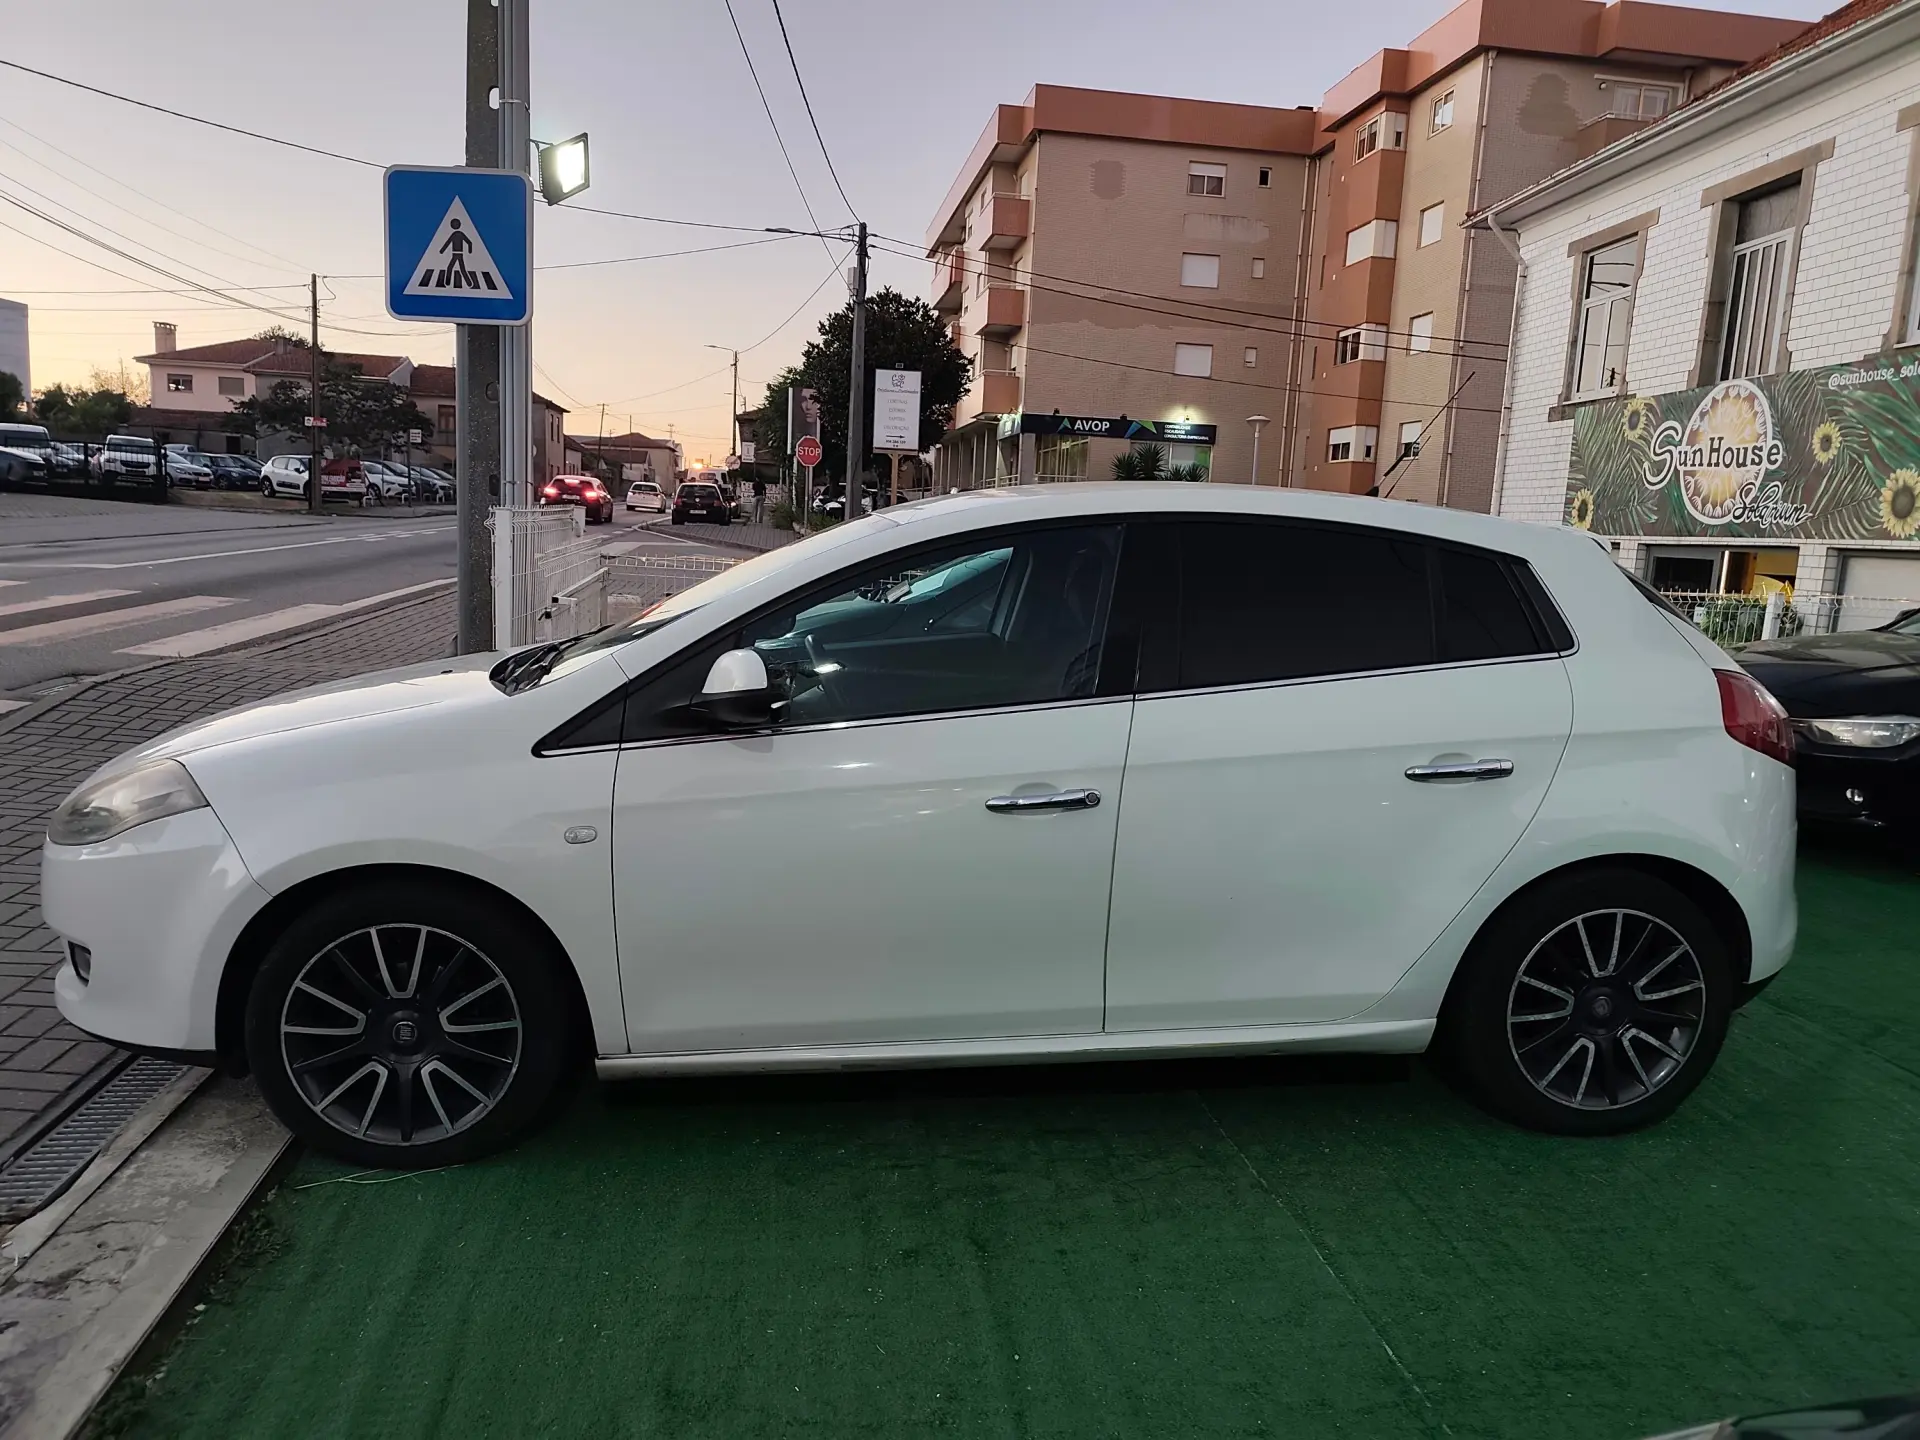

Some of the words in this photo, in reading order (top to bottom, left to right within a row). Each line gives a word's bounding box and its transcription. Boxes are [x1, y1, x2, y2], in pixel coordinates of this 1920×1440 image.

[1074, 419, 1110, 432] AVOP
[798, 446, 820, 456] STOP
[1733, 481, 1808, 527] Solarium
